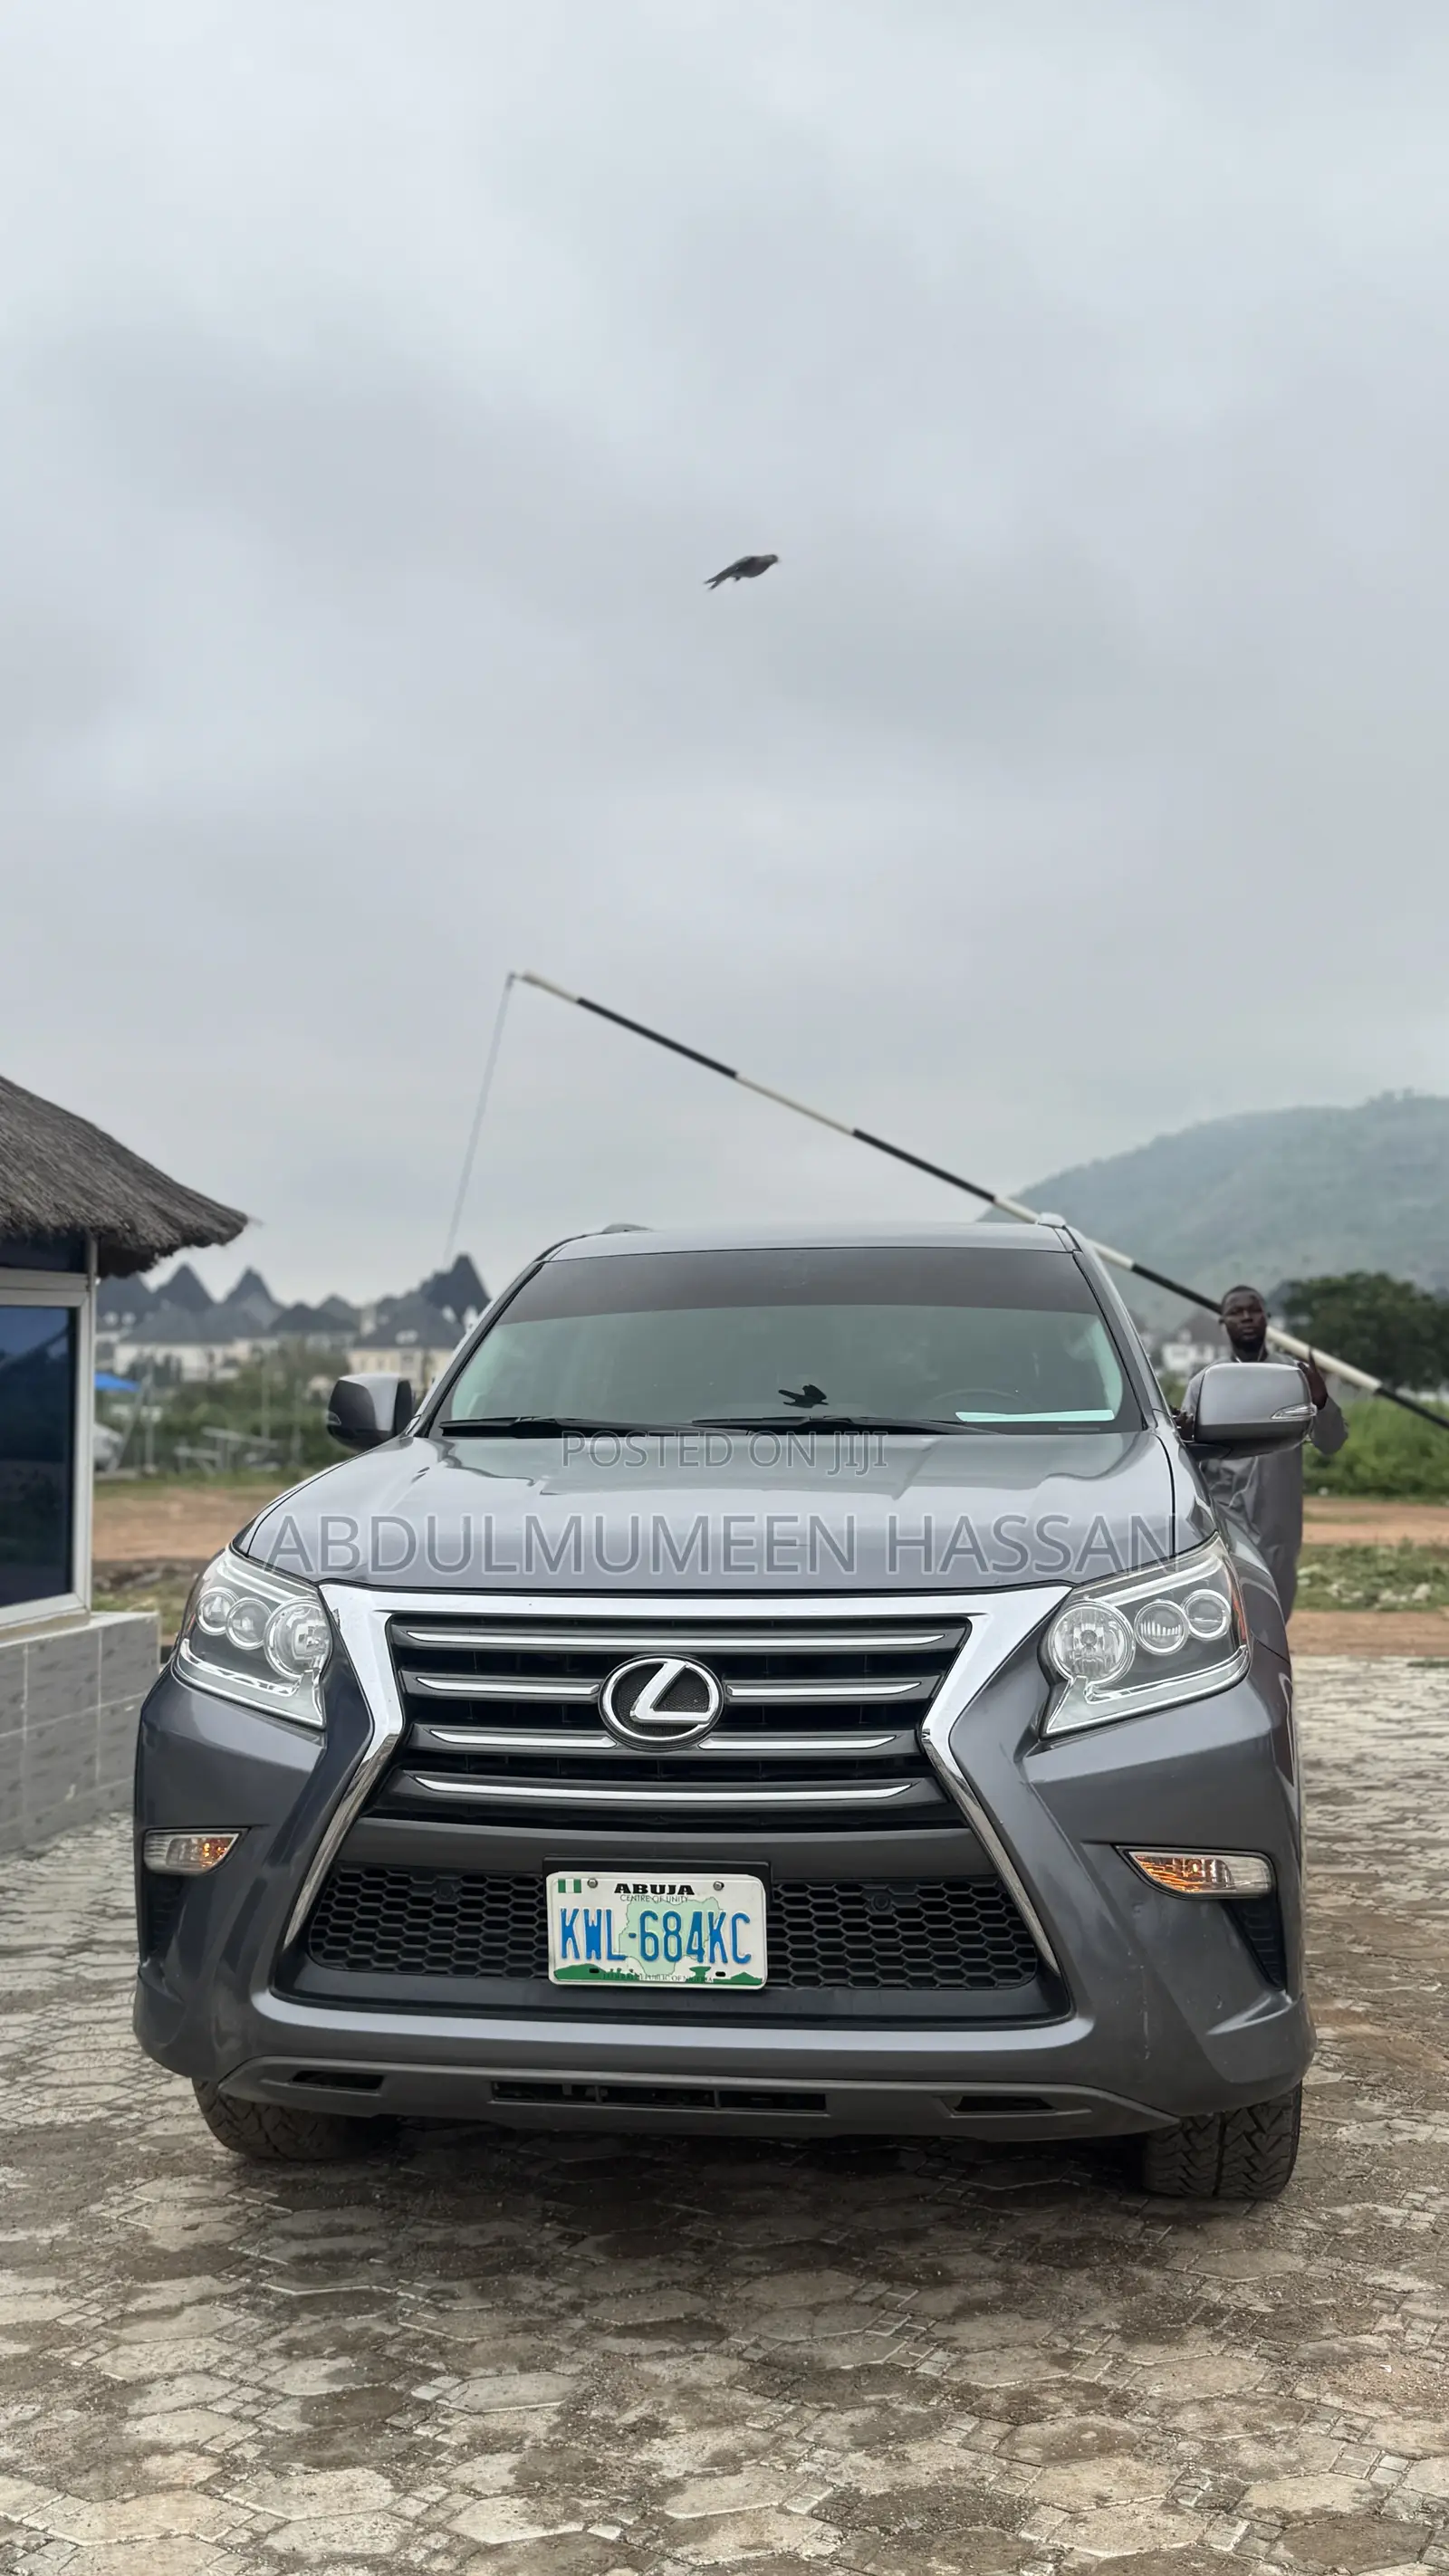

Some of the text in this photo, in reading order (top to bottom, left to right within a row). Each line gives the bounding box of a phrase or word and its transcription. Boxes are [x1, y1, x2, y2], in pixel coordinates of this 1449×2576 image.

[614, 1883, 695, 1895] ABUJA
[619, 1894, 650, 1902] CENTRE
[666, 1895, 689, 1903] UNITY
